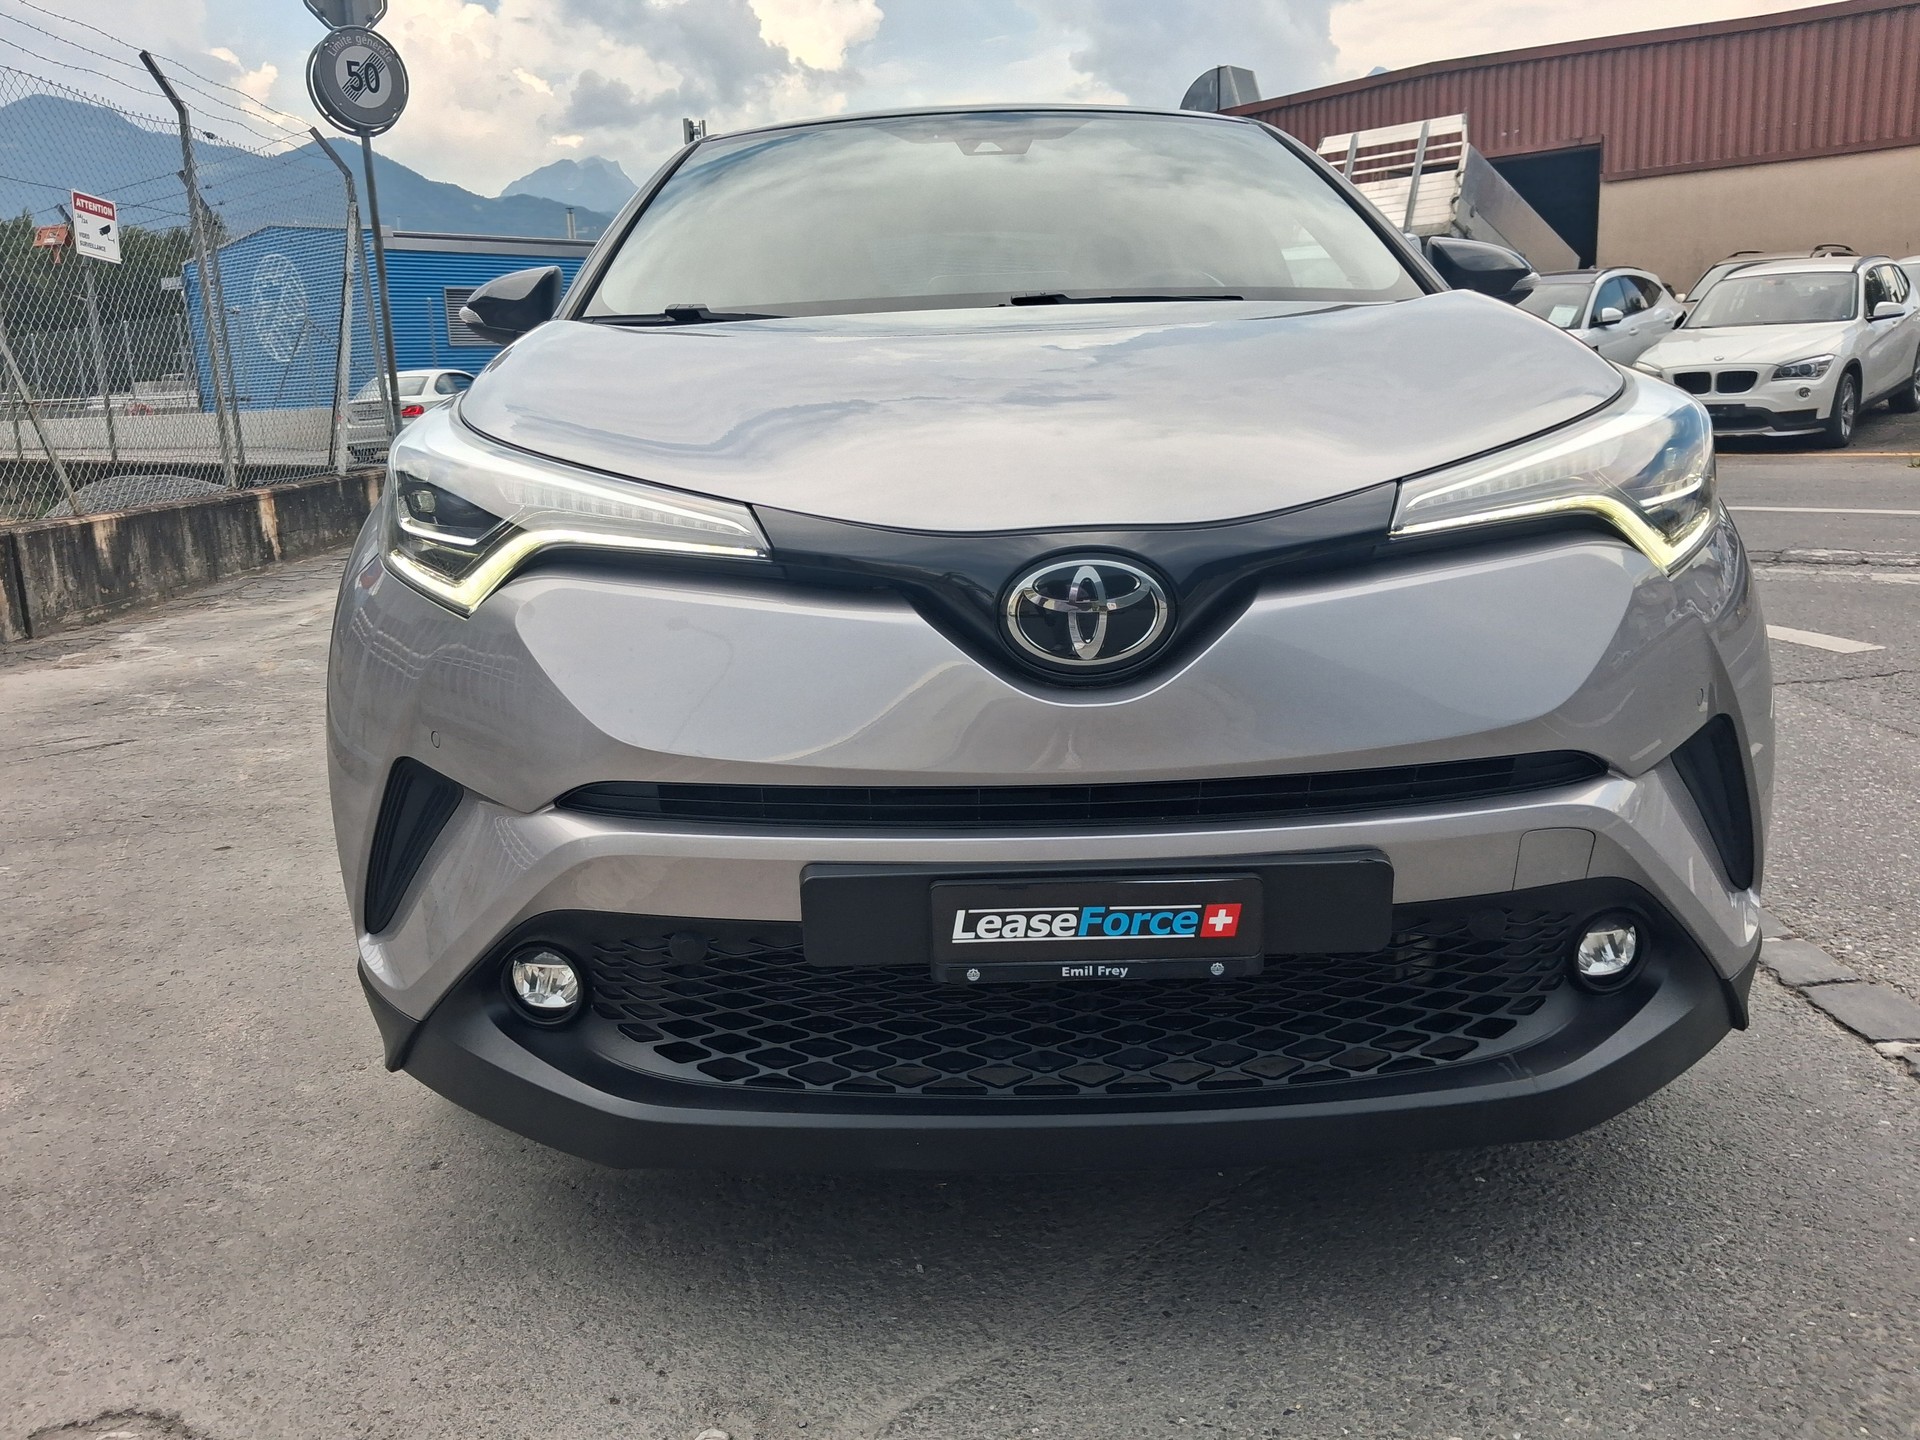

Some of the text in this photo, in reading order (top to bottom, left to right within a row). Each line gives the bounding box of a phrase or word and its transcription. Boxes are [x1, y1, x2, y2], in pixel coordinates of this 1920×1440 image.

[327, 34, 393, 63] Limite générale
[346, 60, 381, 94] 50
[75, 197, 113, 217] ATTENTION
[952, 906, 1199, 940] LeaseForce
[1061, 965, 1129, 978] Emil Frey
